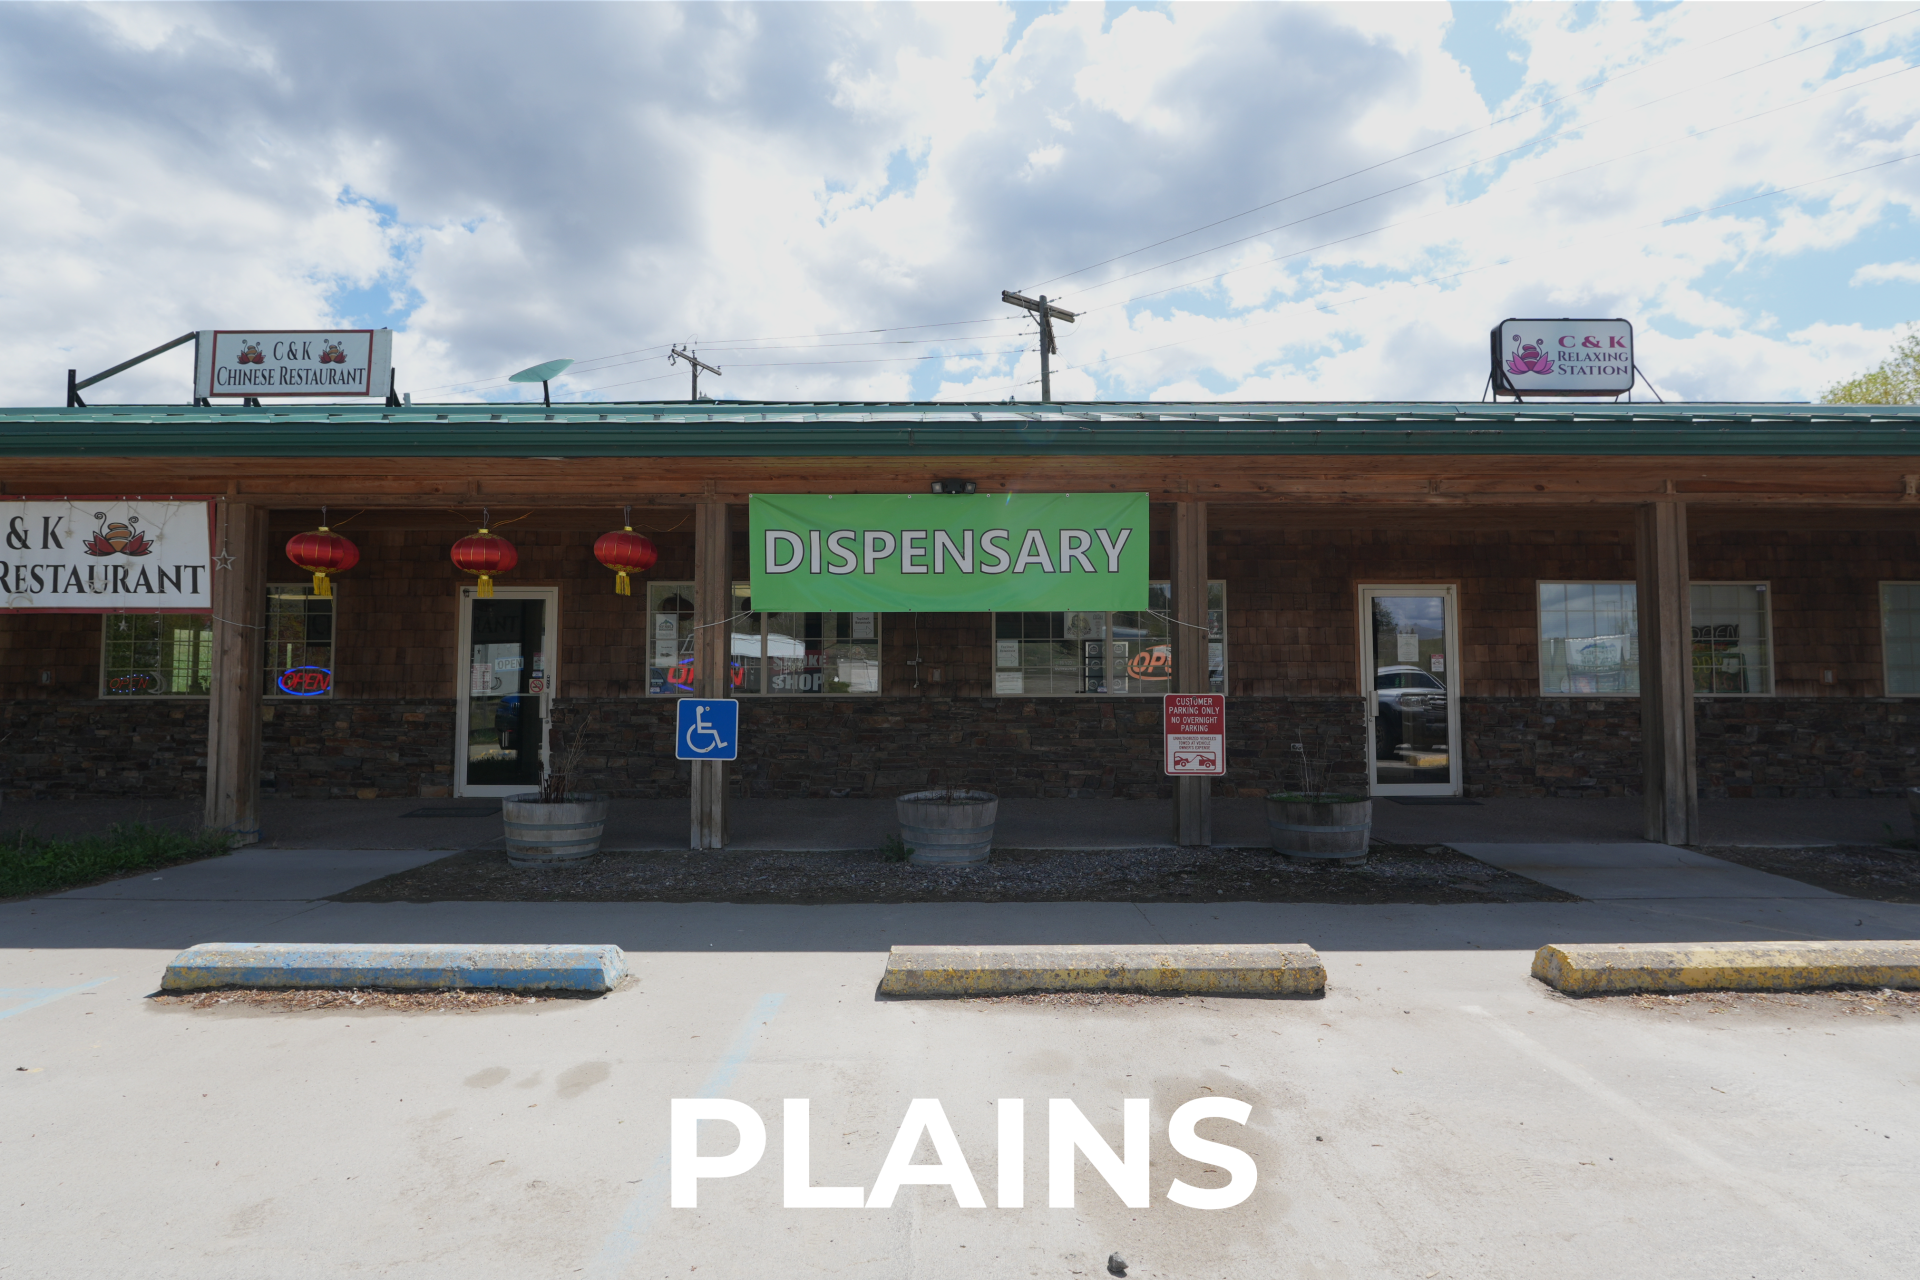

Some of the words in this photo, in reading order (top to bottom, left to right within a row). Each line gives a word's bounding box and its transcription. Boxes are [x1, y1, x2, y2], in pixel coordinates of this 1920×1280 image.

[1558, 335, 1576, 348] C
[1581, 335, 1603, 348] &
[1608, 335, 1628, 348] K
[273, 341, 284, 361] C
[287, 341, 299, 361] &
[302, 341, 312, 360] K
[1557, 350, 1629, 362] RELAXING
[1557, 364, 1628, 375] STATION
[217, 366, 275, 386] CHINESE
[279, 366, 366, 385] RESTAURANT
[6, 516, 32, 550] &
[41, 516, 65, 550] K
[764, 528, 1133, 575] DISPENSARY
[497, 658, 523, 670] OPEN
[773, 653, 827, 670] SKE
[109, 677, 149, 689] OPEN
[281, 671, 331, 690] OPEN
[772, 672, 825, 690] SHOP
[1176, 697, 1213, 706] CUSTOMER
[1168, 706, 1199, 714] PARKING
[1201, 706, 1220, 714] ONLY
[1171, 716, 1181, 724] NO
[1182, 716, 1218, 724] OVERNIGHT
[1180, 724, 1209, 732] PARKING
